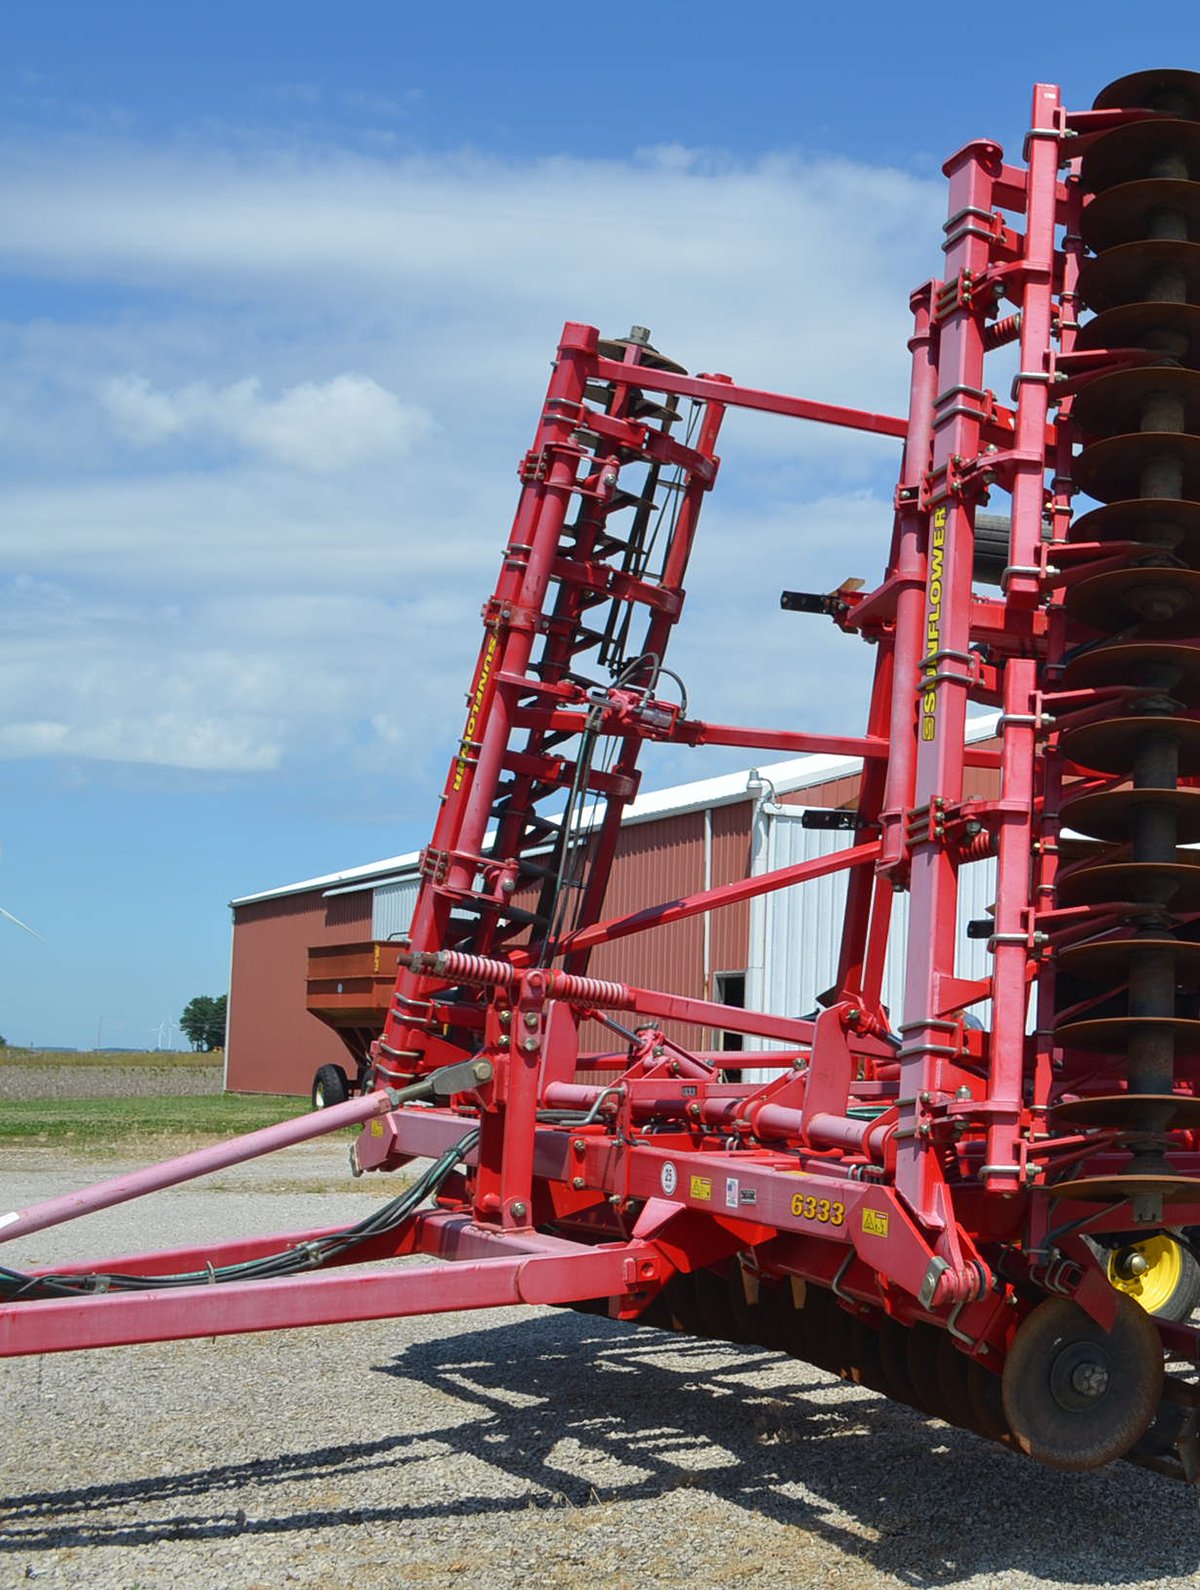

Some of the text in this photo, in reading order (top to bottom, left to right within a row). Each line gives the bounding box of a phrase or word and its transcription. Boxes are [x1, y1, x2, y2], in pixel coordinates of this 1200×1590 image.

[923, 506, 947, 713] SUNFLOWER
[453, 636, 498, 791] SUNFLOWER
[791, 1193, 846, 1227] 6333
